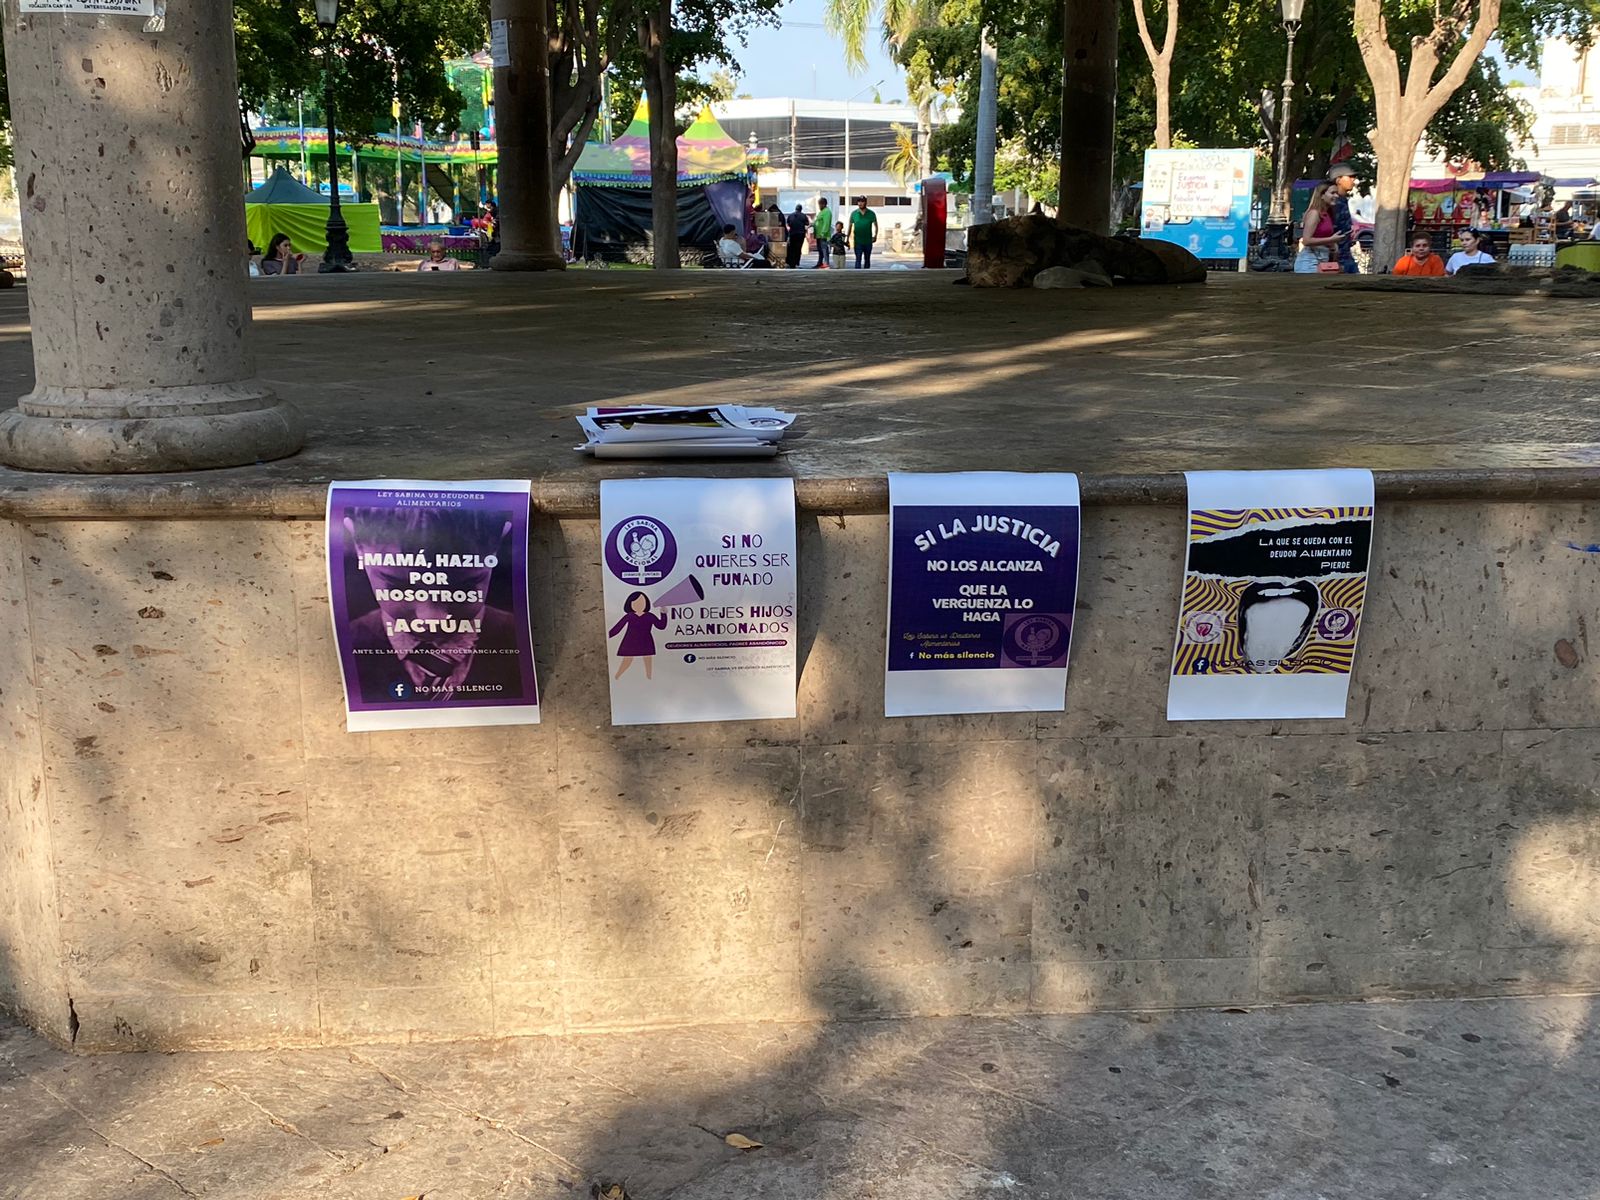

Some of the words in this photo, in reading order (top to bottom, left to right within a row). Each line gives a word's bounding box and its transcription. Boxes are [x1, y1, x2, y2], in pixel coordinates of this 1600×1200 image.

[624, 522, 634, 530] LEY
[636, 520, 658, 531] SABINA
[722, 534, 736, 548] SI
[741, 534, 763, 548] NO
[914, 530, 937, 552] SI
[938, 518, 967, 540] LA
[971, 514, 1061, 558] JUSTICIA
[1259, 538, 1273, 546] LA
[1276, 538, 1290, 546] QUE
[1292, 538, 1301, 546] SE
[1303, 537, 1326, 545] QUEDA
[1344, 536, 1353, 544] EL
[358, 549, 432, 570] ¡MAMÁ,
[436, 554, 498, 568] HAZLO
[1270, 550, 1297, 558] DEUDOR
[1300, 549, 1352, 557] ALIMENTARIO
[625, 555, 658, 566] NACIONAL
[695, 554, 757, 568] QUIERES
[762, 554, 790, 567] SER
[927, 560, 948, 572] NO
[951, 560, 977, 572] LOS
[980, 560, 1043, 572] ALCANZA
[409, 572, 449, 585] POR
[713, 572, 773, 586] FUNADO
[376, 589, 484, 603] NOSOTROS!
[959, 585, 988, 597] QUE
[990, 585, 1008, 595] LA
[1014, 599, 1034, 609] LO
[671, 607, 694, 620] NO
[700, 606, 744, 619] DEJES
[750, 605, 793, 618] HIJOS
[962, 612, 1000, 622] HAGA
[386, 614, 482, 636] ¡ACTÚA!
[675, 622, 789, 636] ABANDONADOS
[934, 651, 955, 659] más
[957, 651, 995, 659] silencio
[456, 684, 503, 692] SILENCIO
